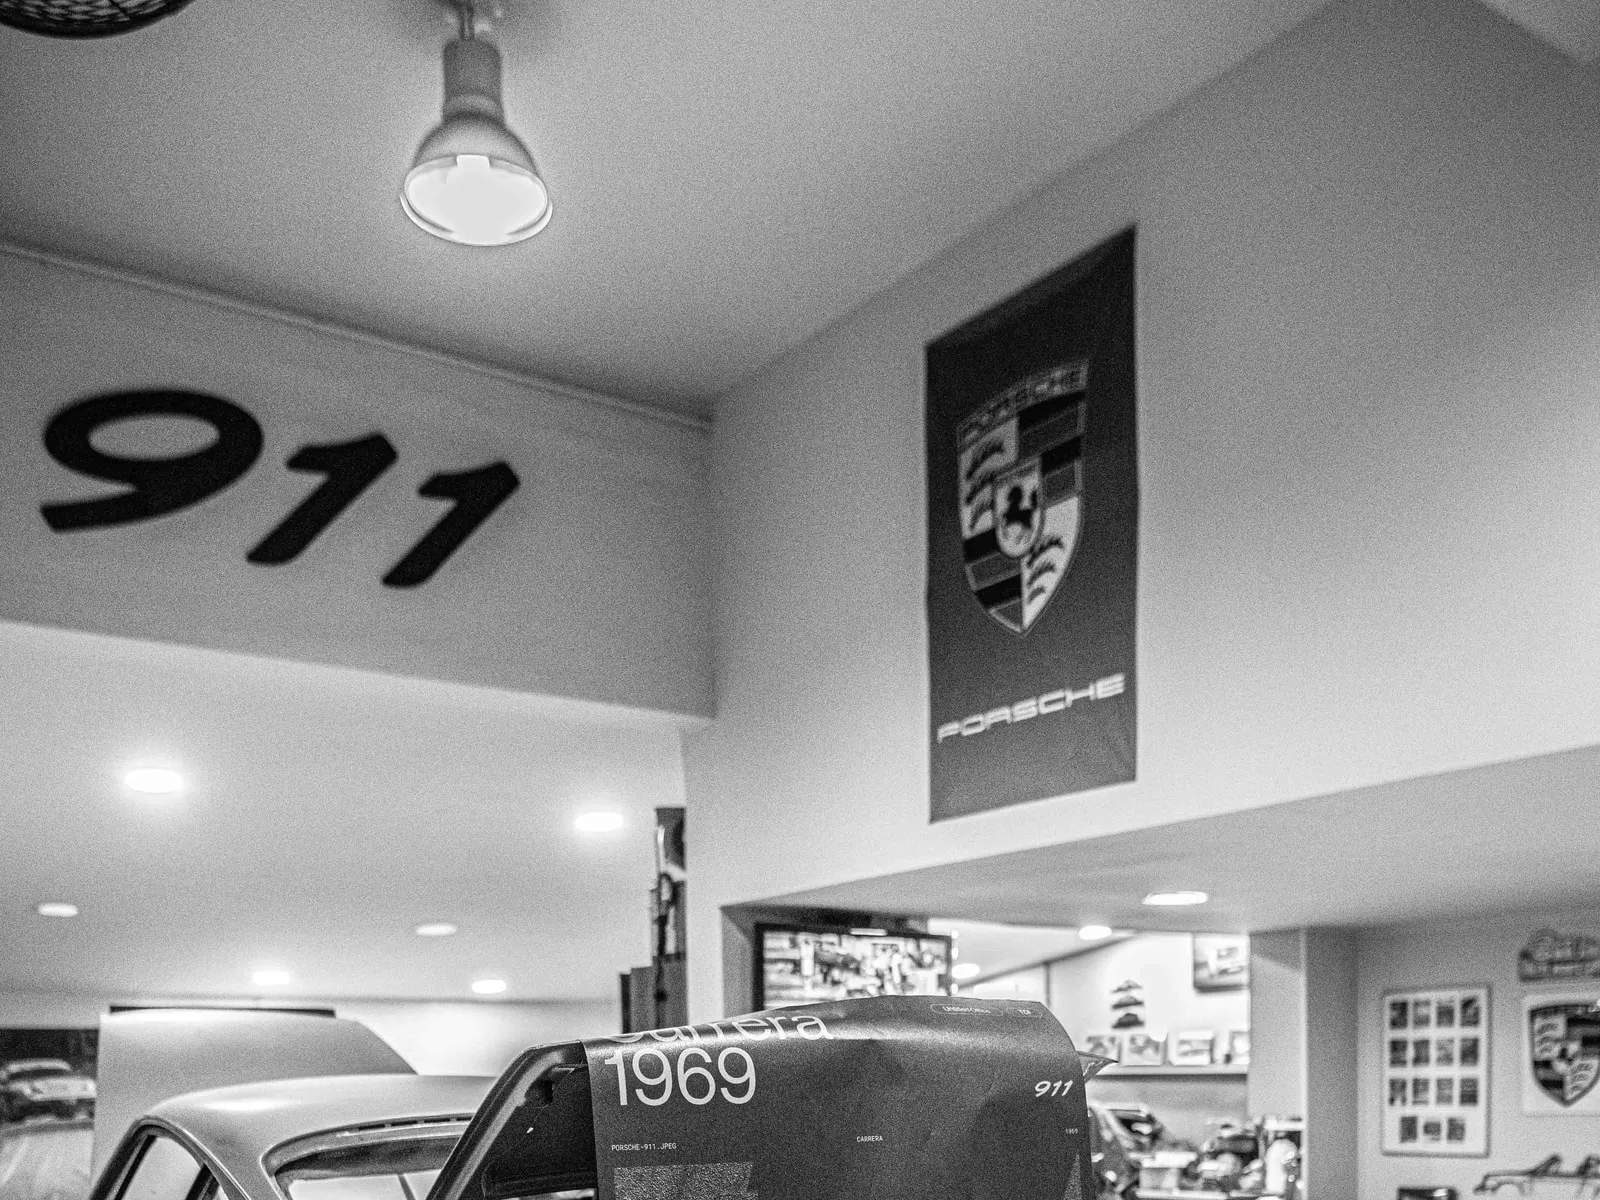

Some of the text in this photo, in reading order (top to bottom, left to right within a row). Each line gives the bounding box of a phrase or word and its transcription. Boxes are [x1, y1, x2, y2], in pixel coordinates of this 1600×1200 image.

[40, 386, 520, 589] 911
[937, 672, 1125, 743] PORSCHE
[604, 1047, 756, 1106] 1969
[1034, 1080, 1074, 1098] 911
[611, 1142, 677, 1151] PORSCHE-911.JPEG
[856, 1135, 883, 1143] CARRERA
